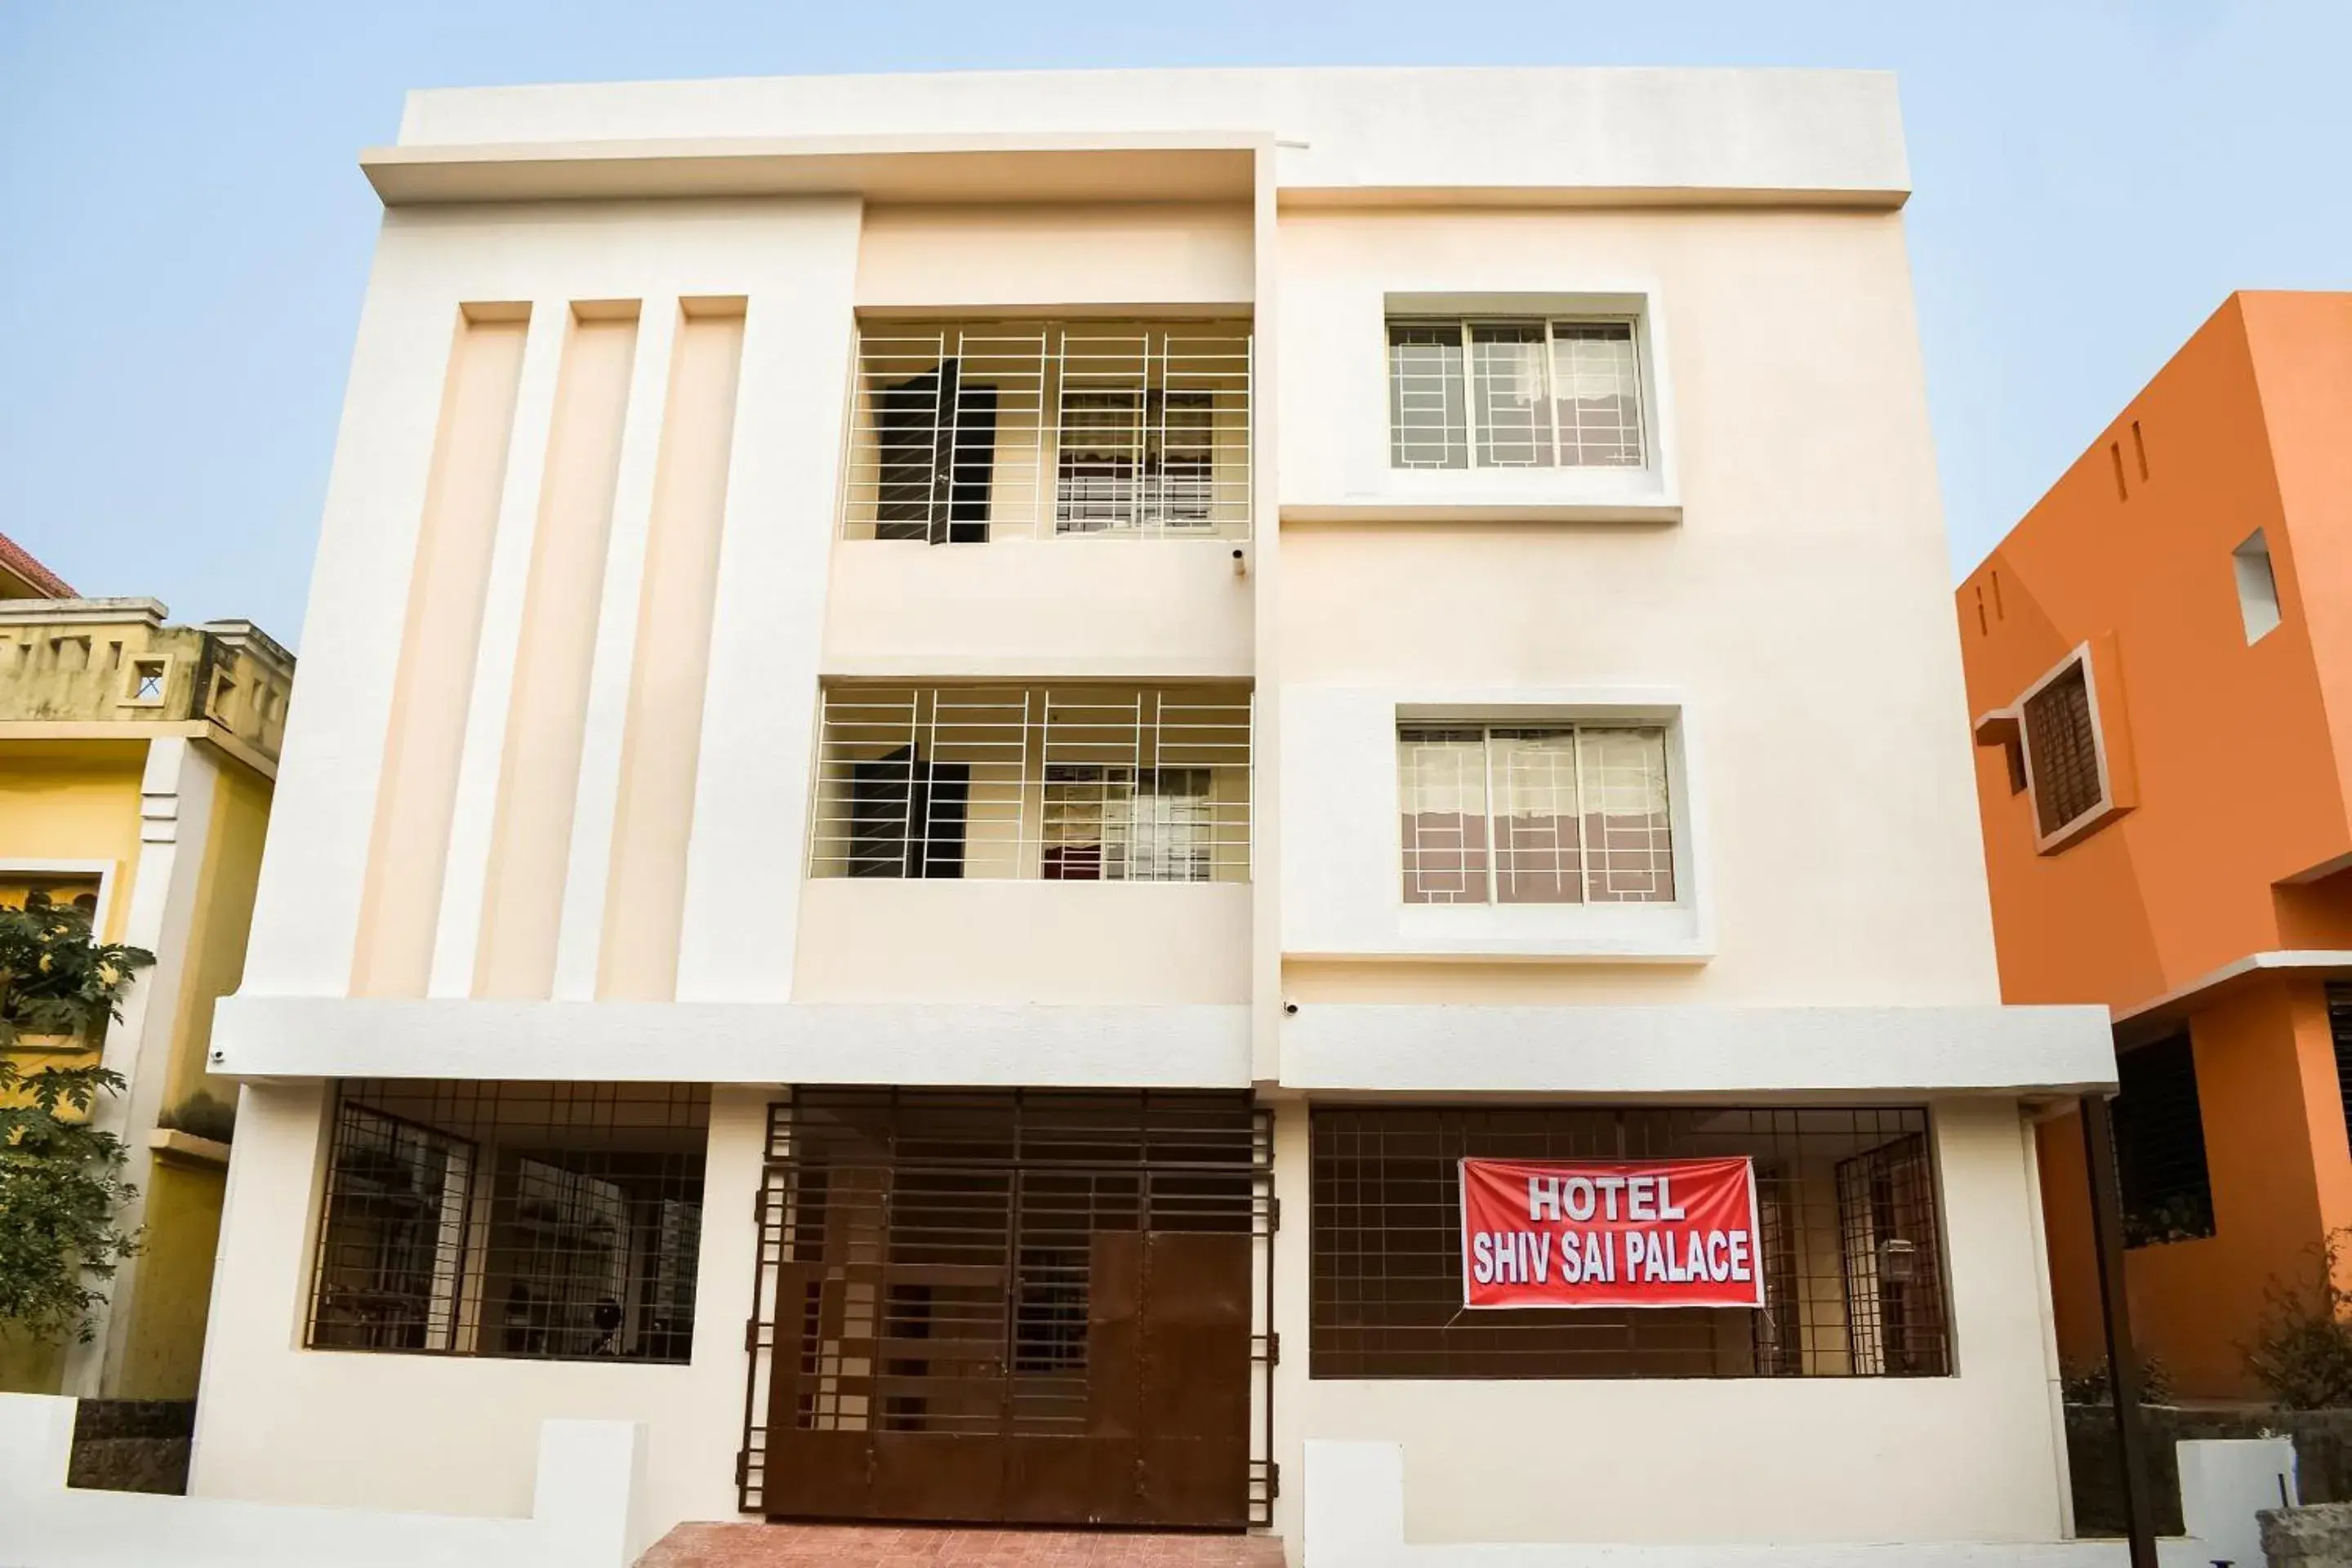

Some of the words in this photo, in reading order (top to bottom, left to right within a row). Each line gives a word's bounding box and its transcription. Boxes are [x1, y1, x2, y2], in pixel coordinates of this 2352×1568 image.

[1529, 1177, 1686, 1222] HOTEL
[1473, 1232, 1551, 1283] SHIV
[1561, 1231, 1616, 1283] SAI
[1625, 1230, 1751, 1282] PALACE
